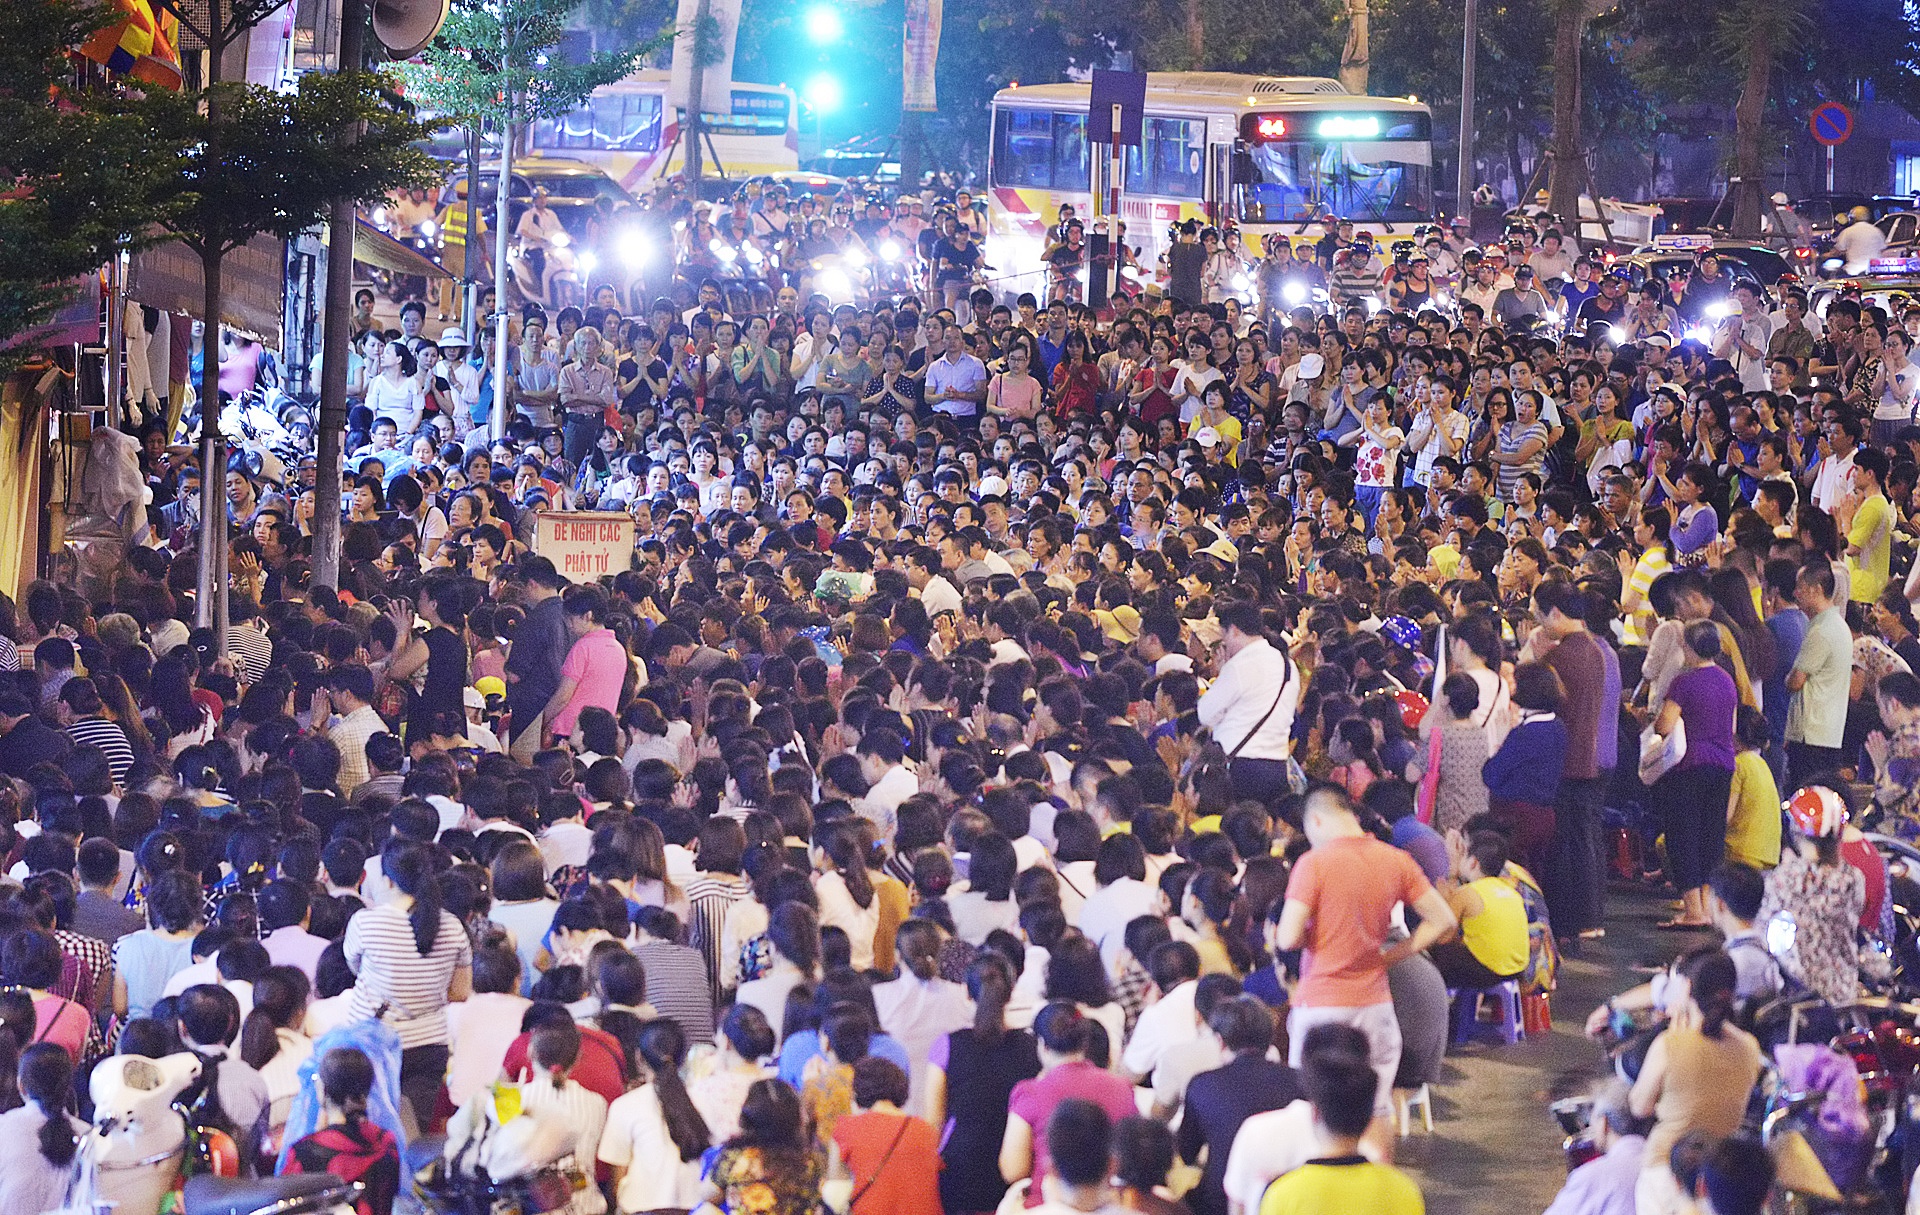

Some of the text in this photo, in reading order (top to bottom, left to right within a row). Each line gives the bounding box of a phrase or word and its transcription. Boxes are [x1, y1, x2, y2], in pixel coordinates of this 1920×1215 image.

[1259, 119, 1286, 136] 44
[571, 523, 597, 545] NGHỊ
[599, 521, 621, 542] CÁC
[565, 547, 609, 576] PHẬT TỬ
